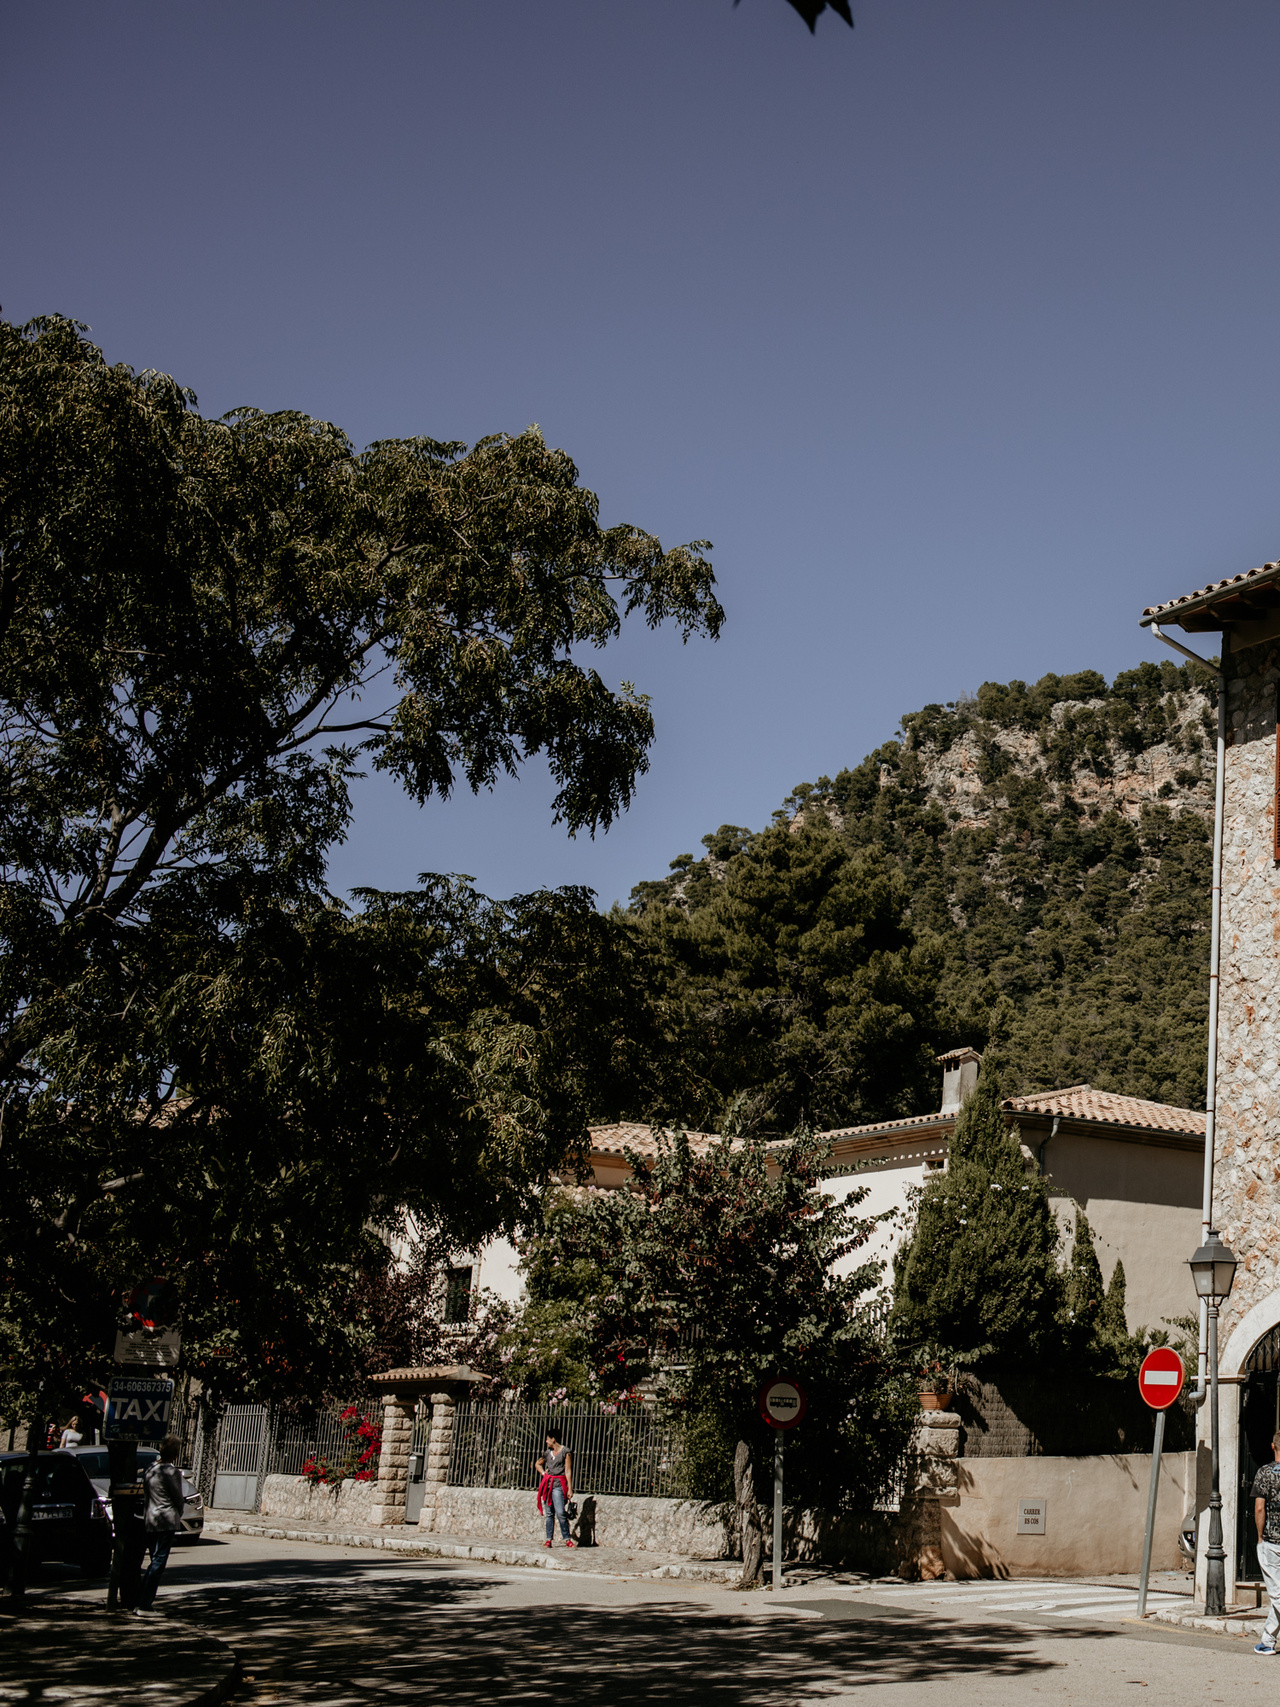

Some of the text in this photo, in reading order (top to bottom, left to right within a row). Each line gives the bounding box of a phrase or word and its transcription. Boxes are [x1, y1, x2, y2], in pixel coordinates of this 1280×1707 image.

[113, 1380, 172, 1393] 34-606367375
[110, 1397, 171, 1422] TAXI
[1024, 1517, 1030, 1525] ES
